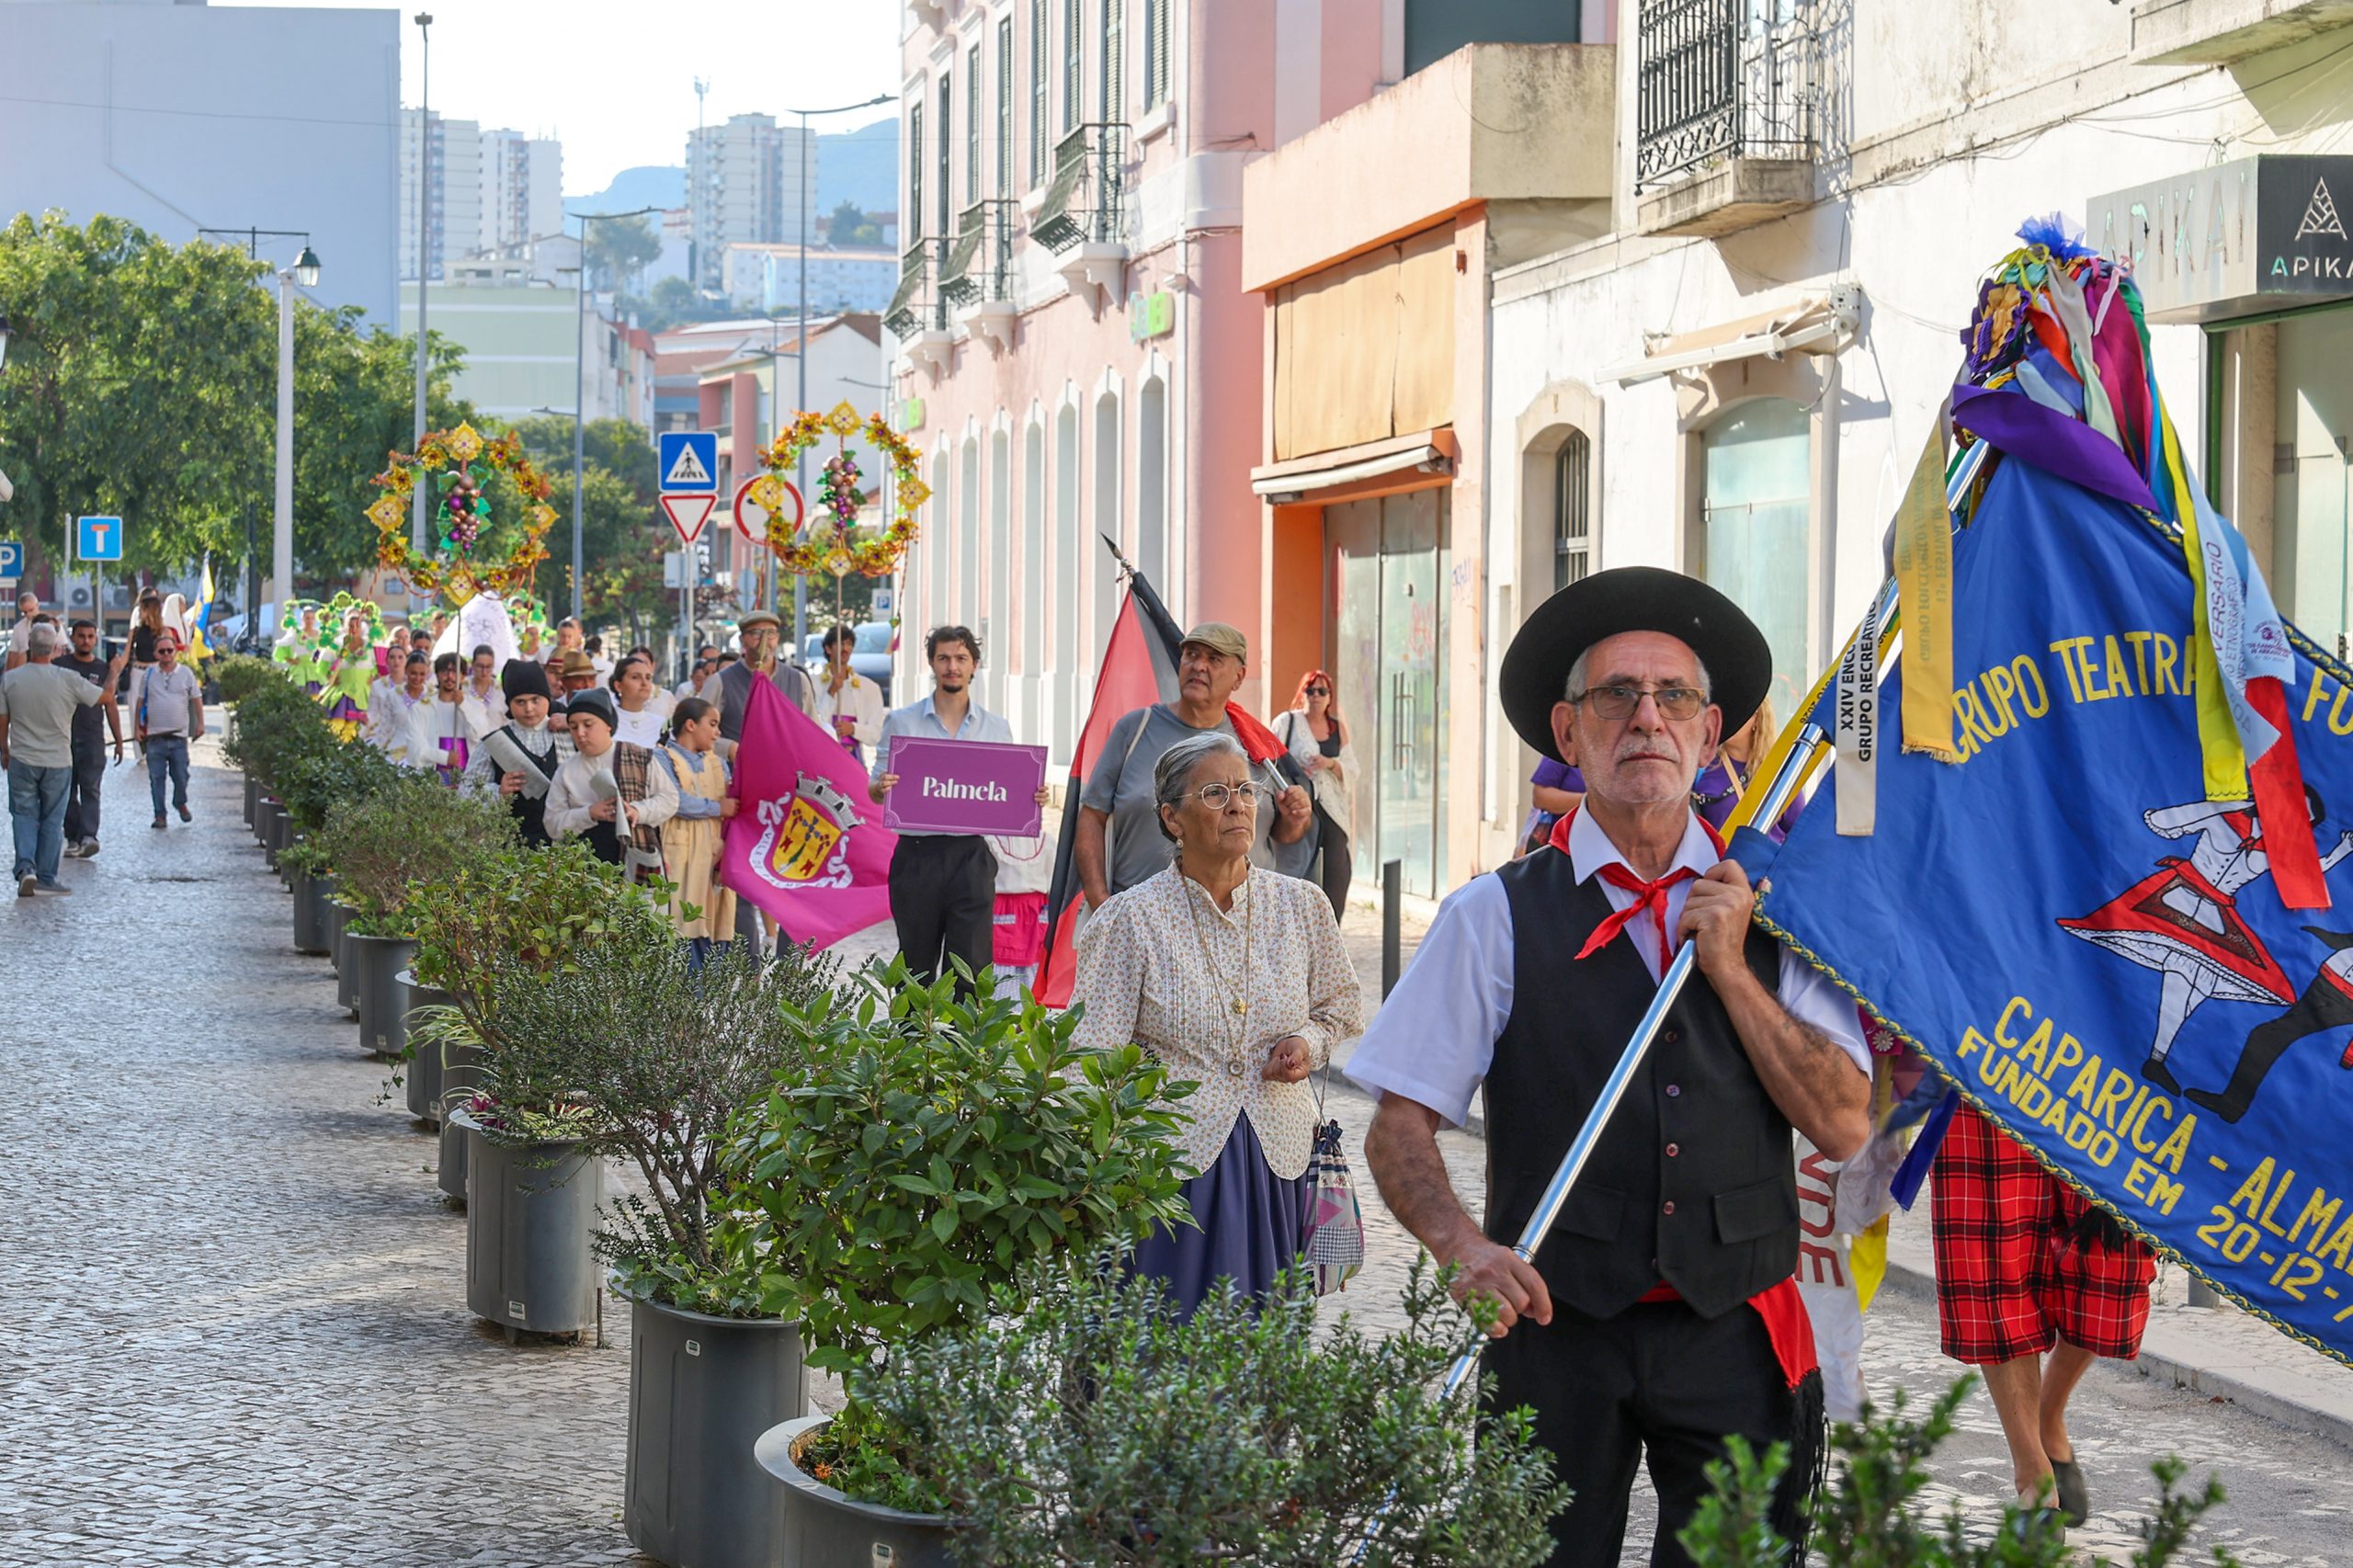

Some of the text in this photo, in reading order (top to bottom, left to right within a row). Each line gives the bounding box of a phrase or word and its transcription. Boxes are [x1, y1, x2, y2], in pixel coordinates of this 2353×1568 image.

[1840, 688, 1854, 731] XXIV
[1859, 699, 1872, 762] GRUPO
[922, 776, 1007, 802] Palmela
[1955, 1025, 2120, 1168] FUNDADO
[2121, 1157, 2186, 1217] EM
[1994, 996, 2198, 1176] CAPARICA
[2228, 1155, 2353, 1278] ALMA
